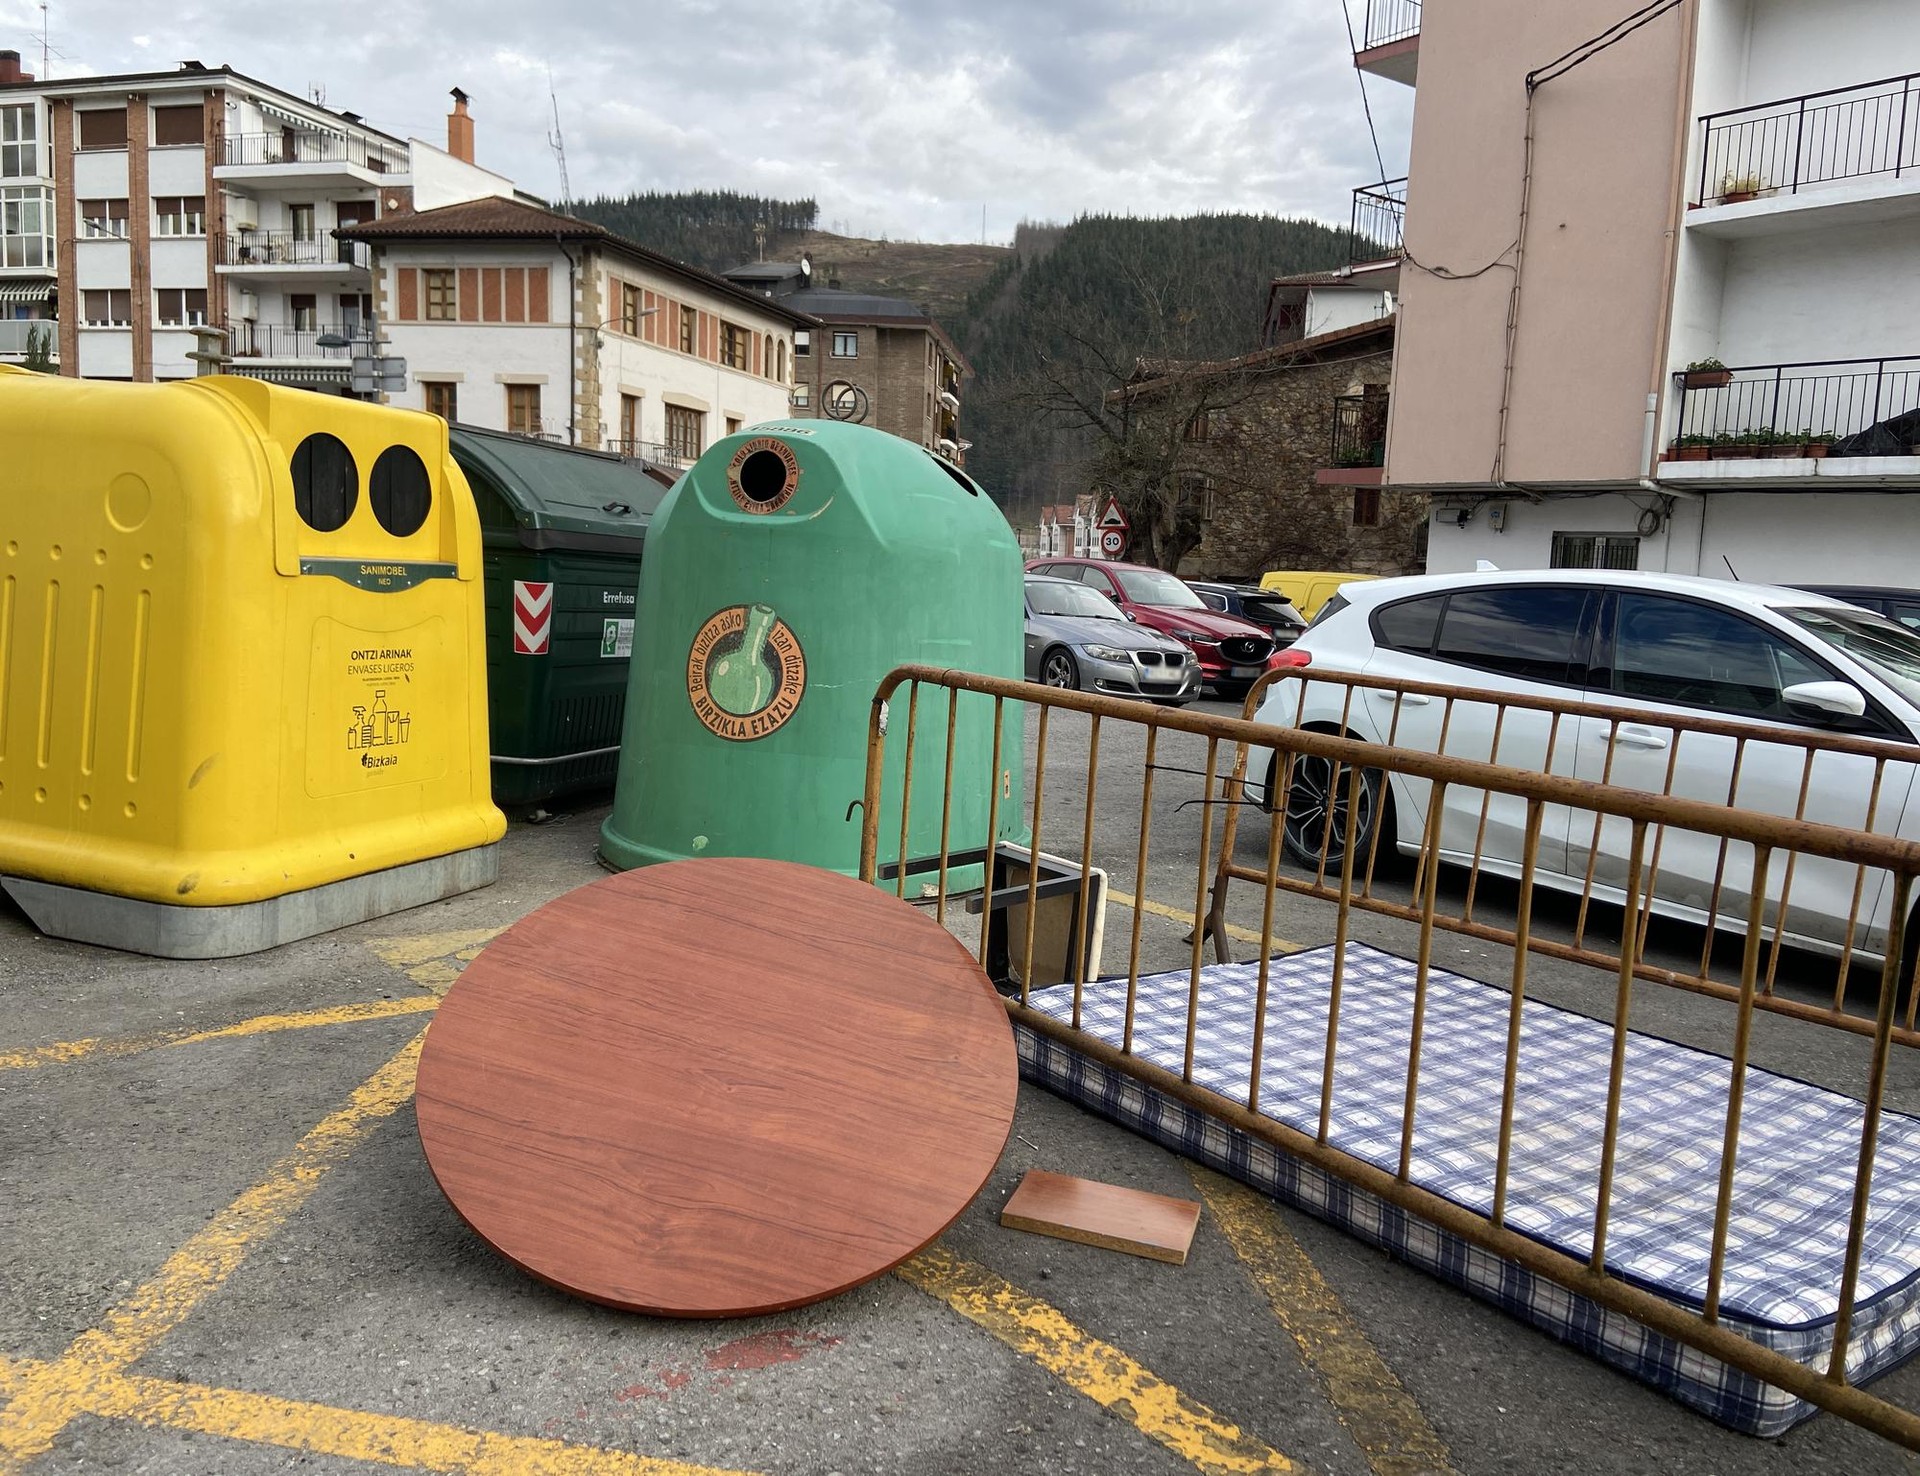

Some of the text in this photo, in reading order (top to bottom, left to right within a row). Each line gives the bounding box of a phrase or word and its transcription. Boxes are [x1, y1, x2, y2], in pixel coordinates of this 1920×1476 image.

[1105, 537, 1120, 546] 30
[360, 564, 408, 576] SANIMOBEL
[378, 578, 391, 586] NEO
[603, 591, 635, 604] Errefusa
[351, 649, 412, 661] ONTZI ARINAK
[690, 612, 802, 695] Beirak bizitza asko izan ditzake
[347, 662, 415, 675] ENVASES LIGEROS
[695, 696, 793, 737] BIRZIKLA EZAZU
[367, 753, 398, 768] Bizkaia
